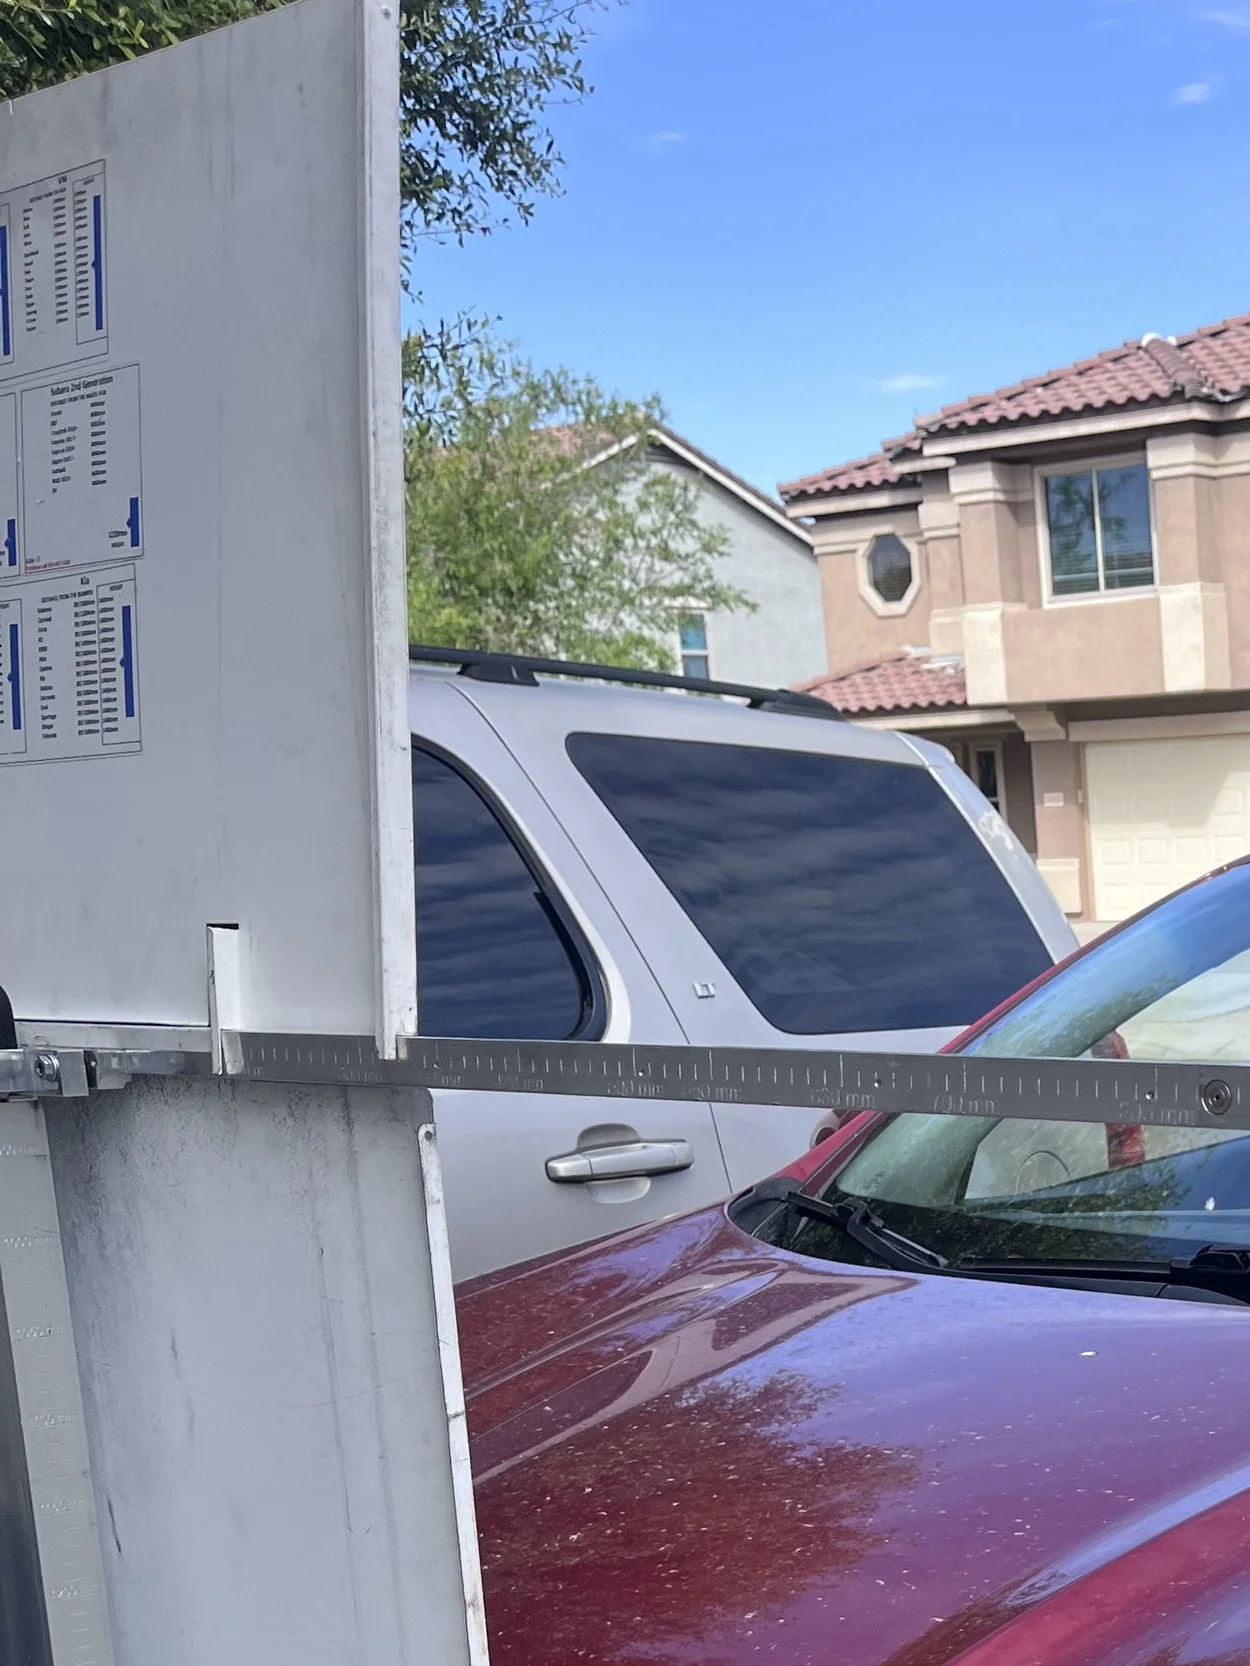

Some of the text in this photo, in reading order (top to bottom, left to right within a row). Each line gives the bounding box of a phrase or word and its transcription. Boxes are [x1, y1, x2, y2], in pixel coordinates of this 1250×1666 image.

[50, 385, 69, 396] Subaru
[82, 376, 113, 389] Generation
[638, 1083, 664, 1097] mm
[715, 1087, 742, 1101] mm
[846, 1092, 875, 1109] mm
[969, 1099, 997, 1114] mm
[1160, 1108, 1195, 1125] mm
